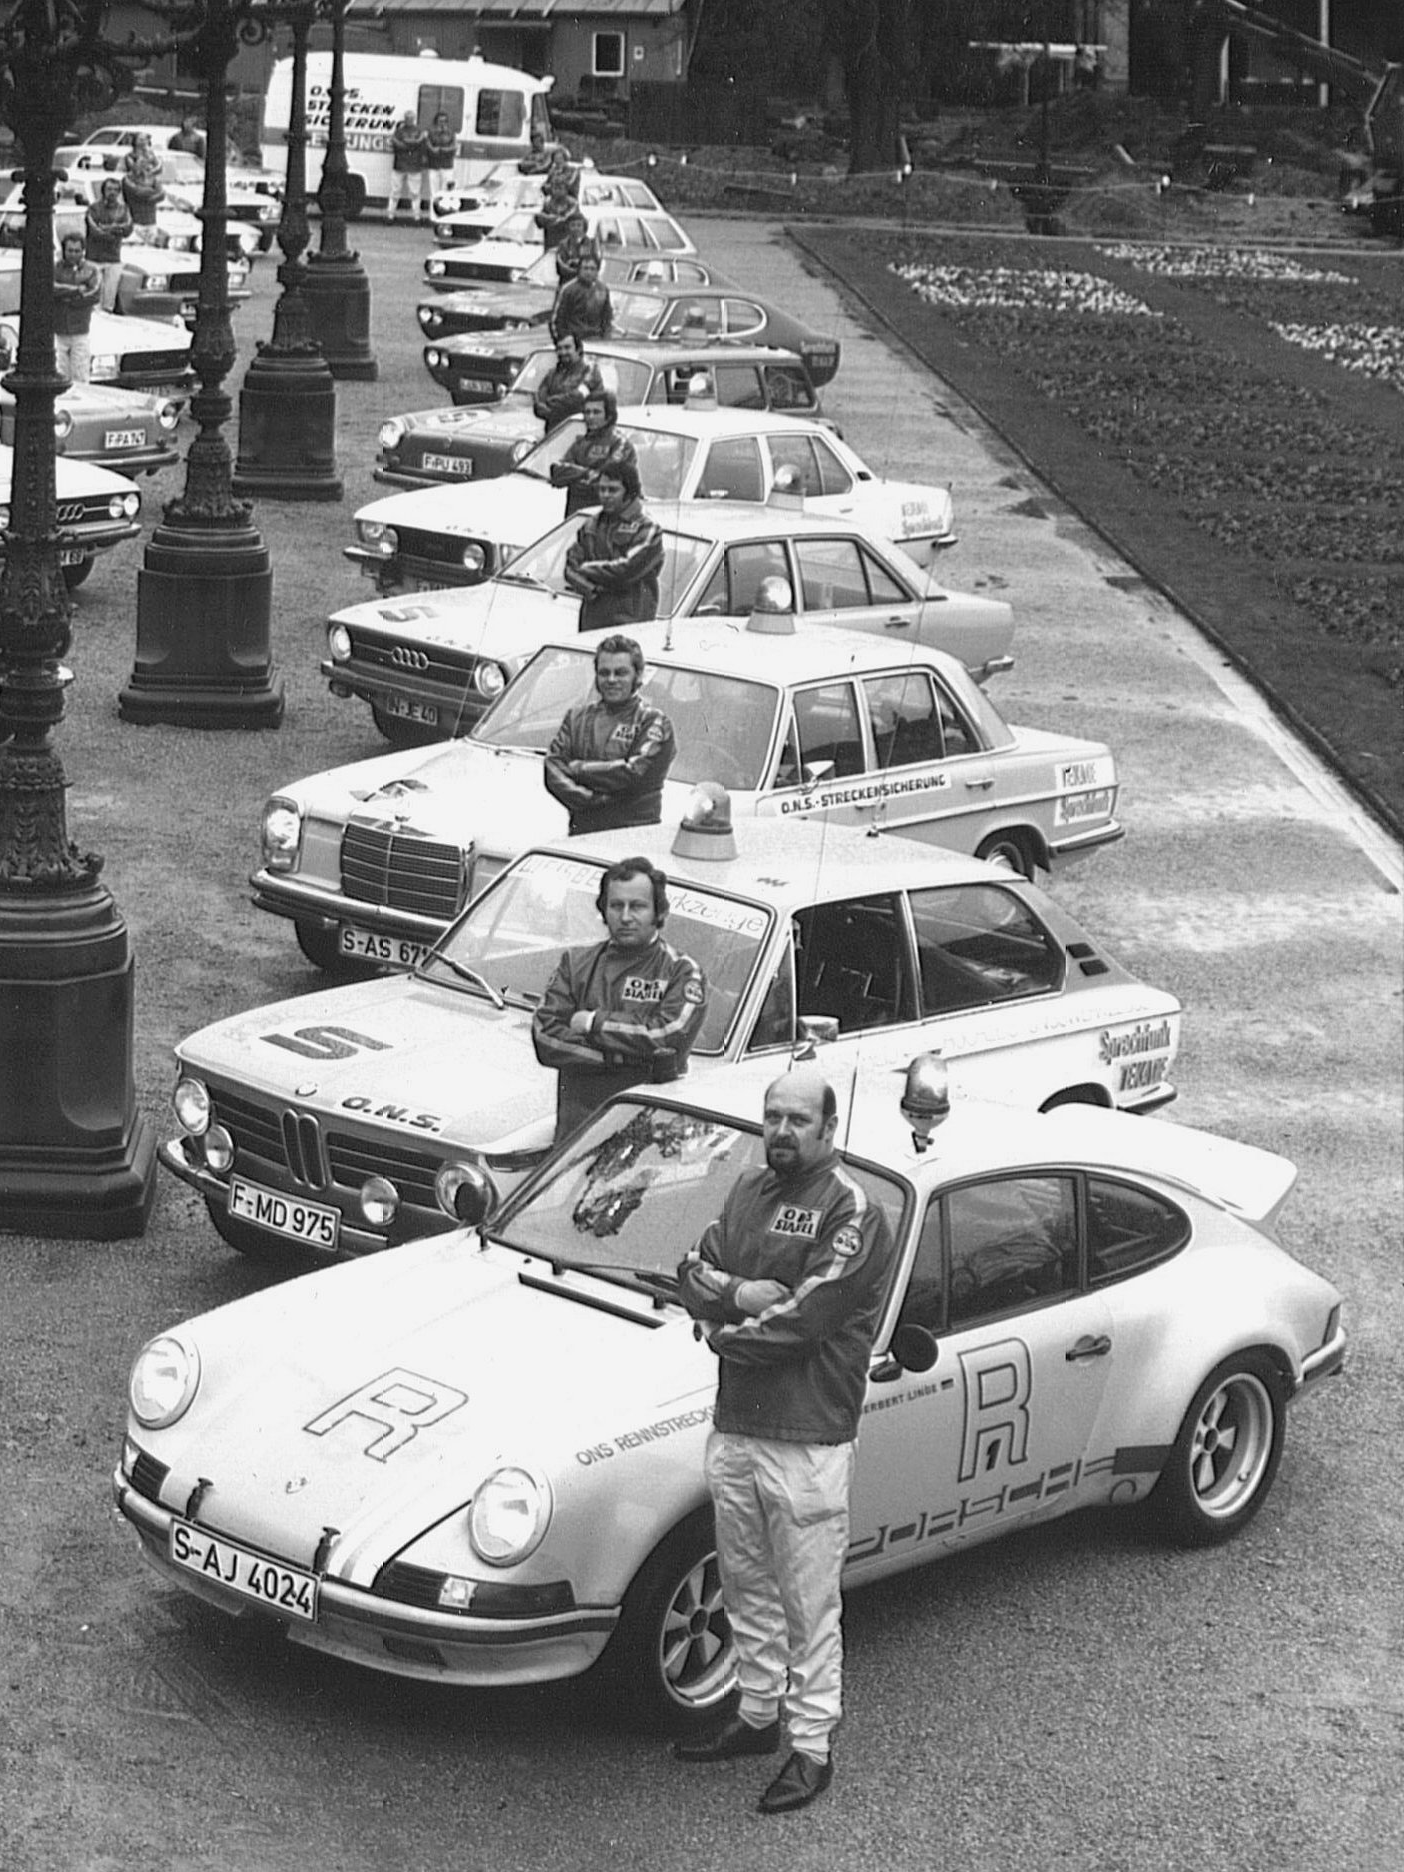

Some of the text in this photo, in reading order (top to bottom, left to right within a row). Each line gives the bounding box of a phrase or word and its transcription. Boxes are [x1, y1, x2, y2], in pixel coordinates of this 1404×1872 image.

[343, 930, 392, 959] S-AS
[342, 1096, 443, 1133] O.N.S.
[232, 1183, 335, 1243] F-MD 975
[863, 1393, 907, 1415] ERBERT
[575, 1442, 615, 1467] ONS
[247, 1562, 312, 1615] 4024
